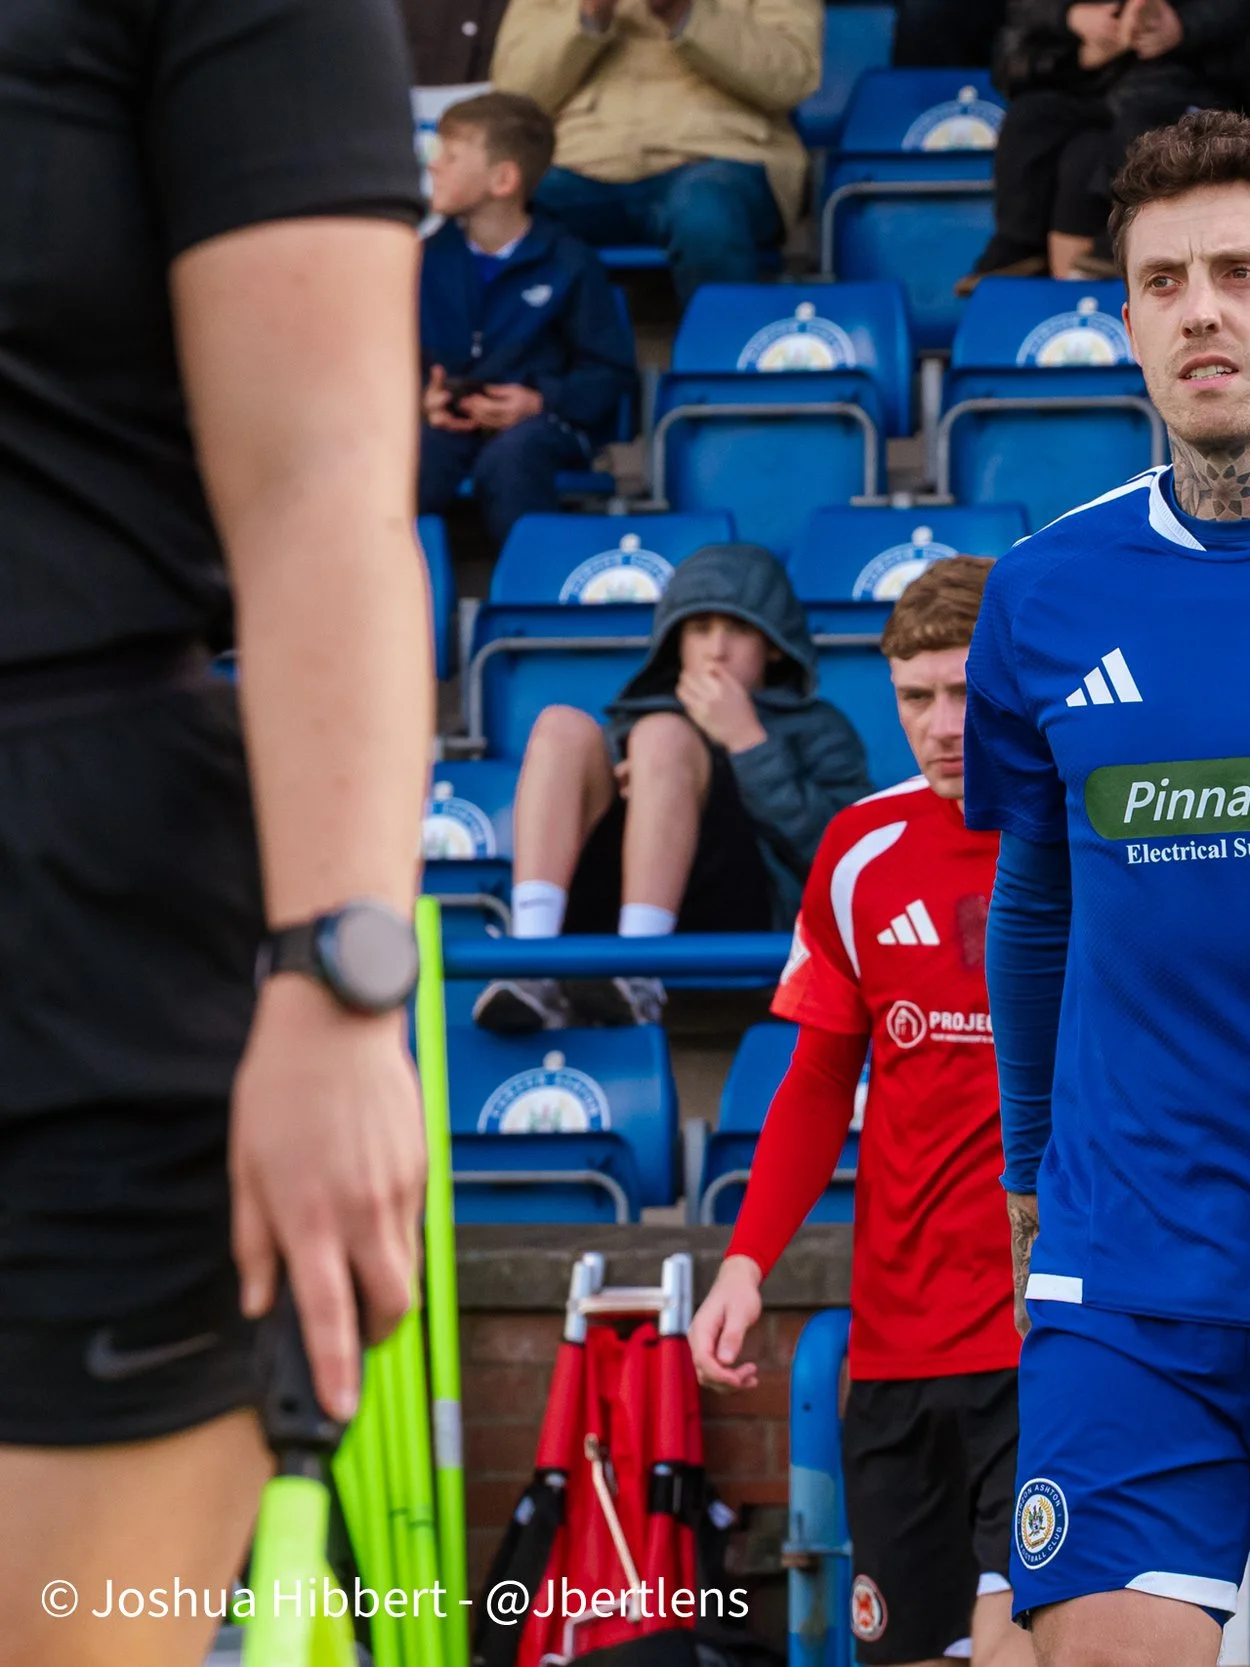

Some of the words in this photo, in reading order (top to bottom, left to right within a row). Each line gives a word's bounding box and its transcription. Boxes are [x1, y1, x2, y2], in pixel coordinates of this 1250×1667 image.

[1126, 839, 1228, 865] Electrical
[1034, 1484, 1062, 1507] ASHTON
[1047, 1526, 1063, 1552] CLUB
